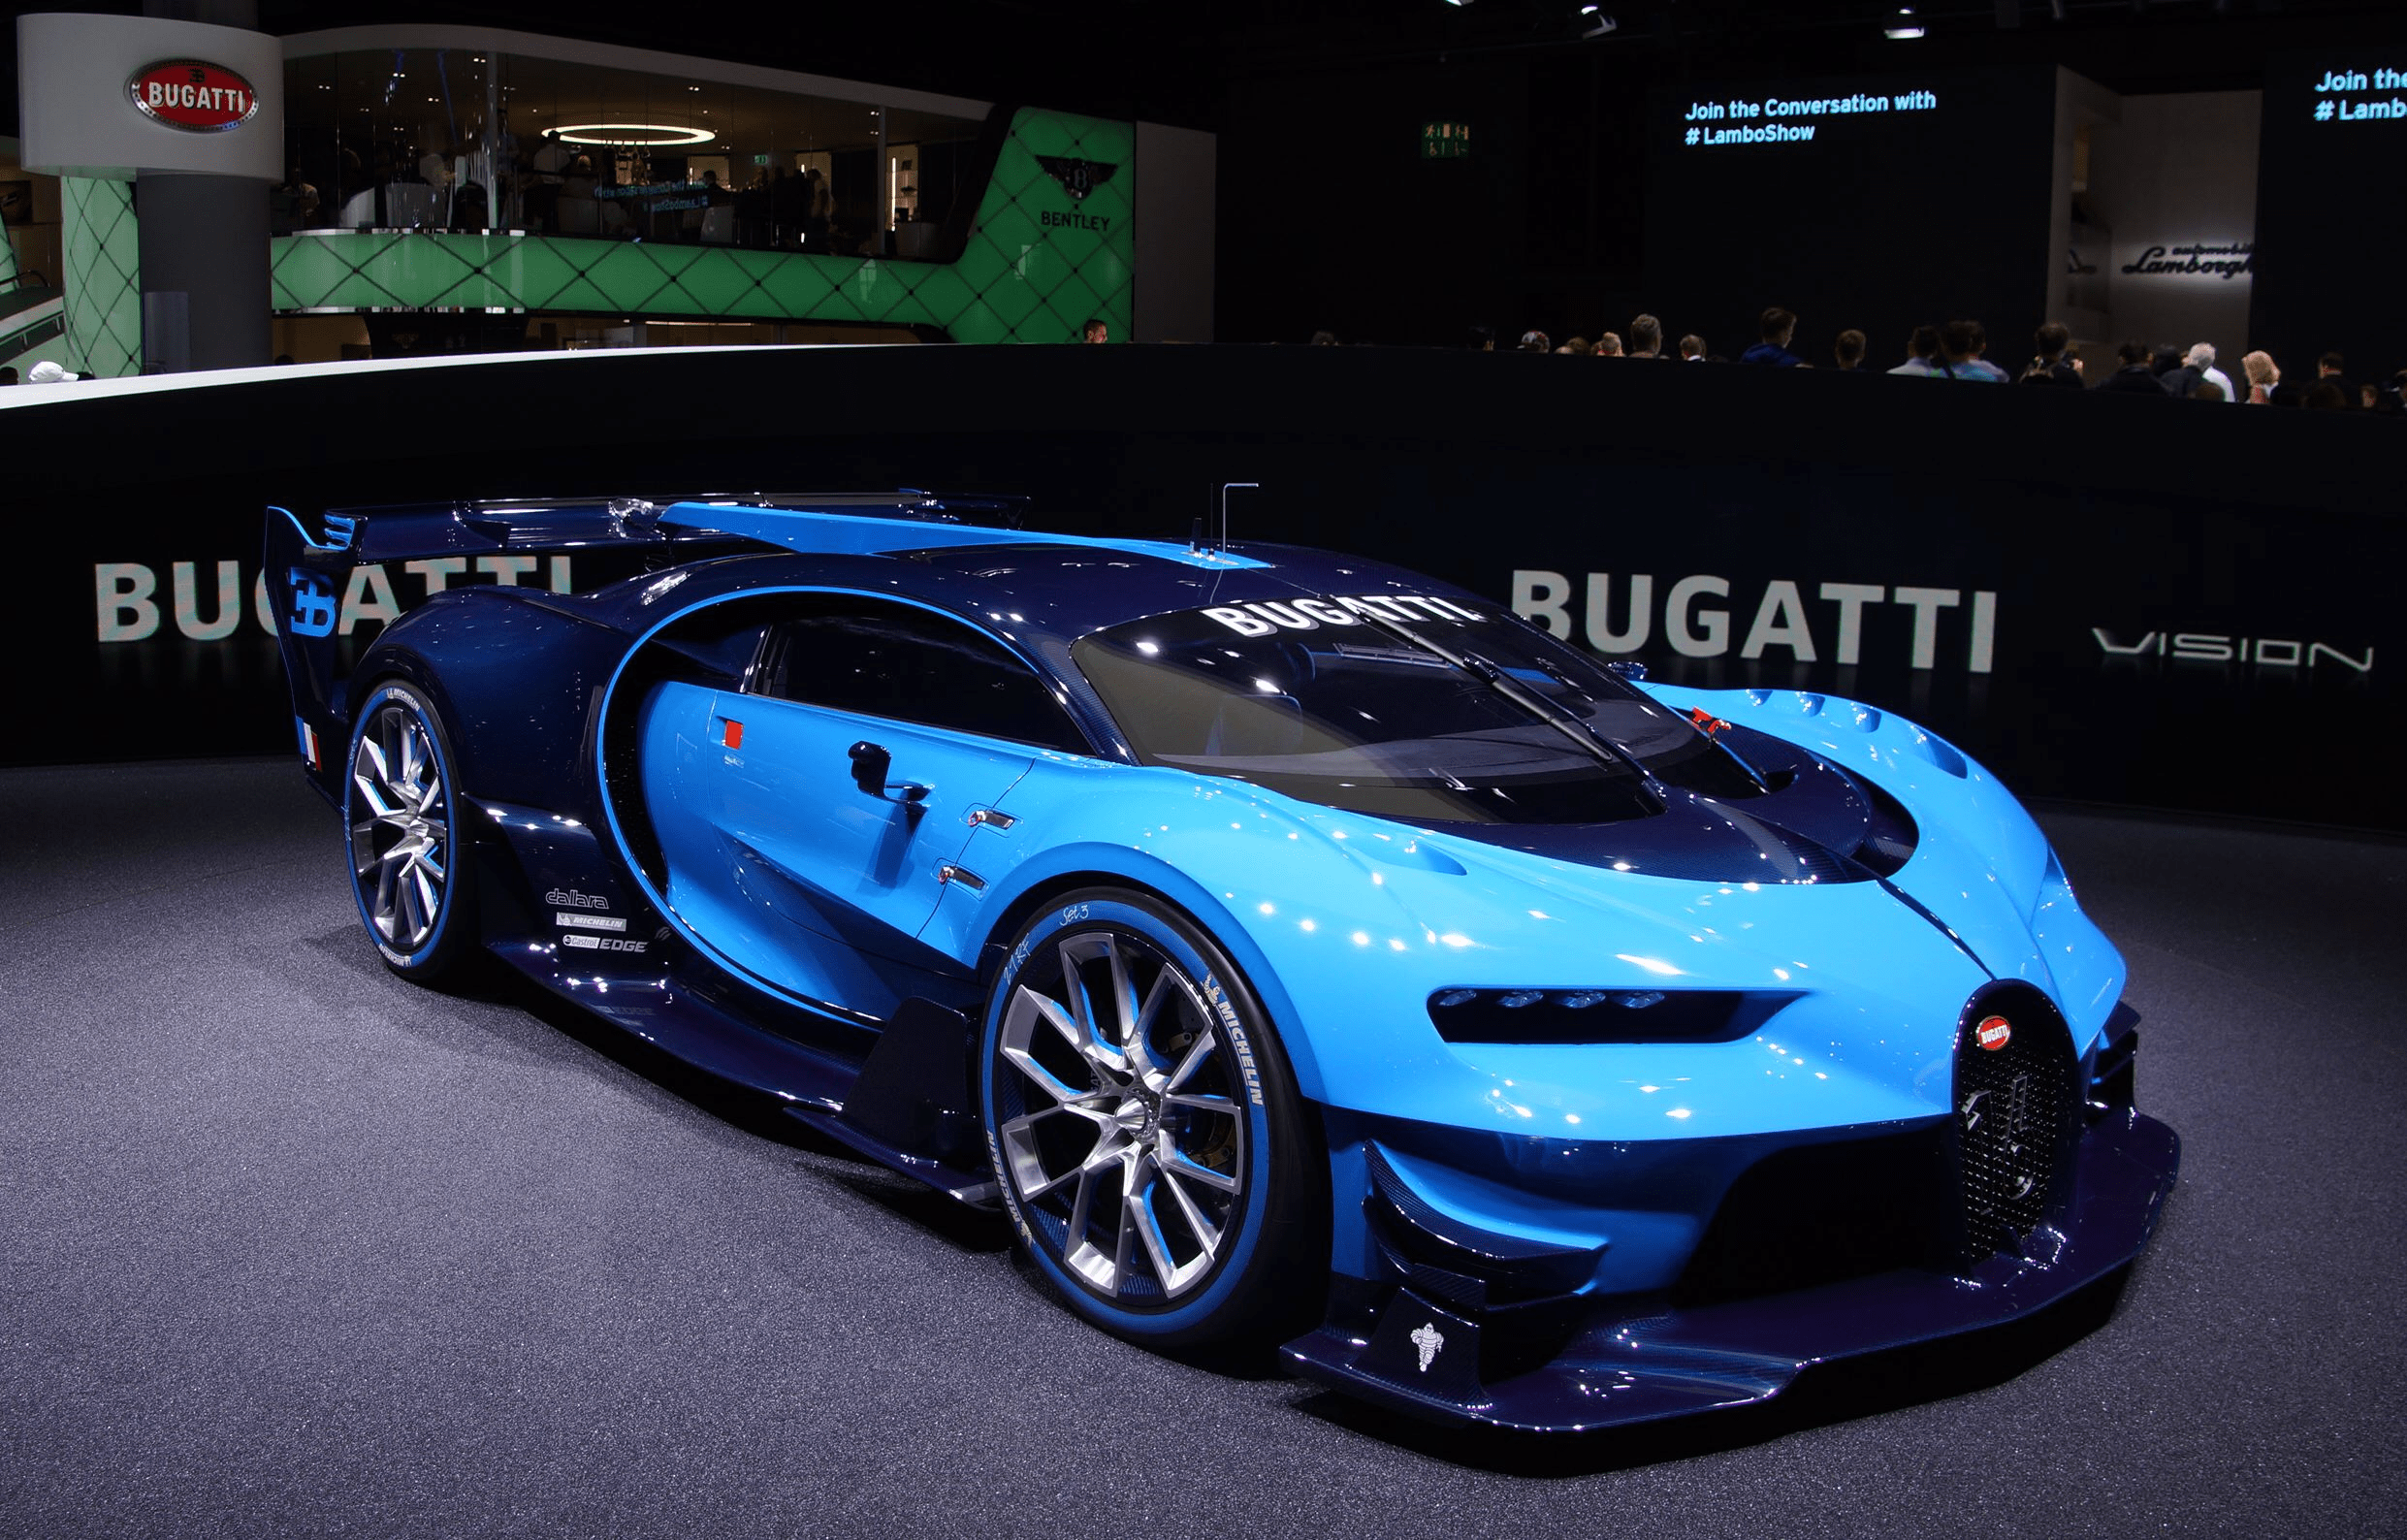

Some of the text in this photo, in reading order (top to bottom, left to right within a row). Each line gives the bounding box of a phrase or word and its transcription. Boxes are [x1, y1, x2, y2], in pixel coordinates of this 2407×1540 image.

[2314, 70, 2368, 92] Join
[148, 81, 245, 113] BUGATTI
[1685, 90, 1937, 120] Join the Conversation with
[2339, 97, 2407, 120] Lamb
[1703, 123, 1815, 144] LamboShow
[1041, 210, 1110, 232] BENTLEY
[1201, 595, 1484, 638] BUGATTI
[1511, 569, 1998, 673] BUGATTI
[2092, 627, 2374, 671] VISION
[545, 887, 610, 910] dallara
[572, 916, 624, 928] MICHELIN
[1059, 907, 1080, 926] Set
[571, 937, 649, 953] Castrol EDGE
[1218, 1000, 1264, 1106] MICHELIN
[986, 1129, 1021, 1223] MICHELIN
